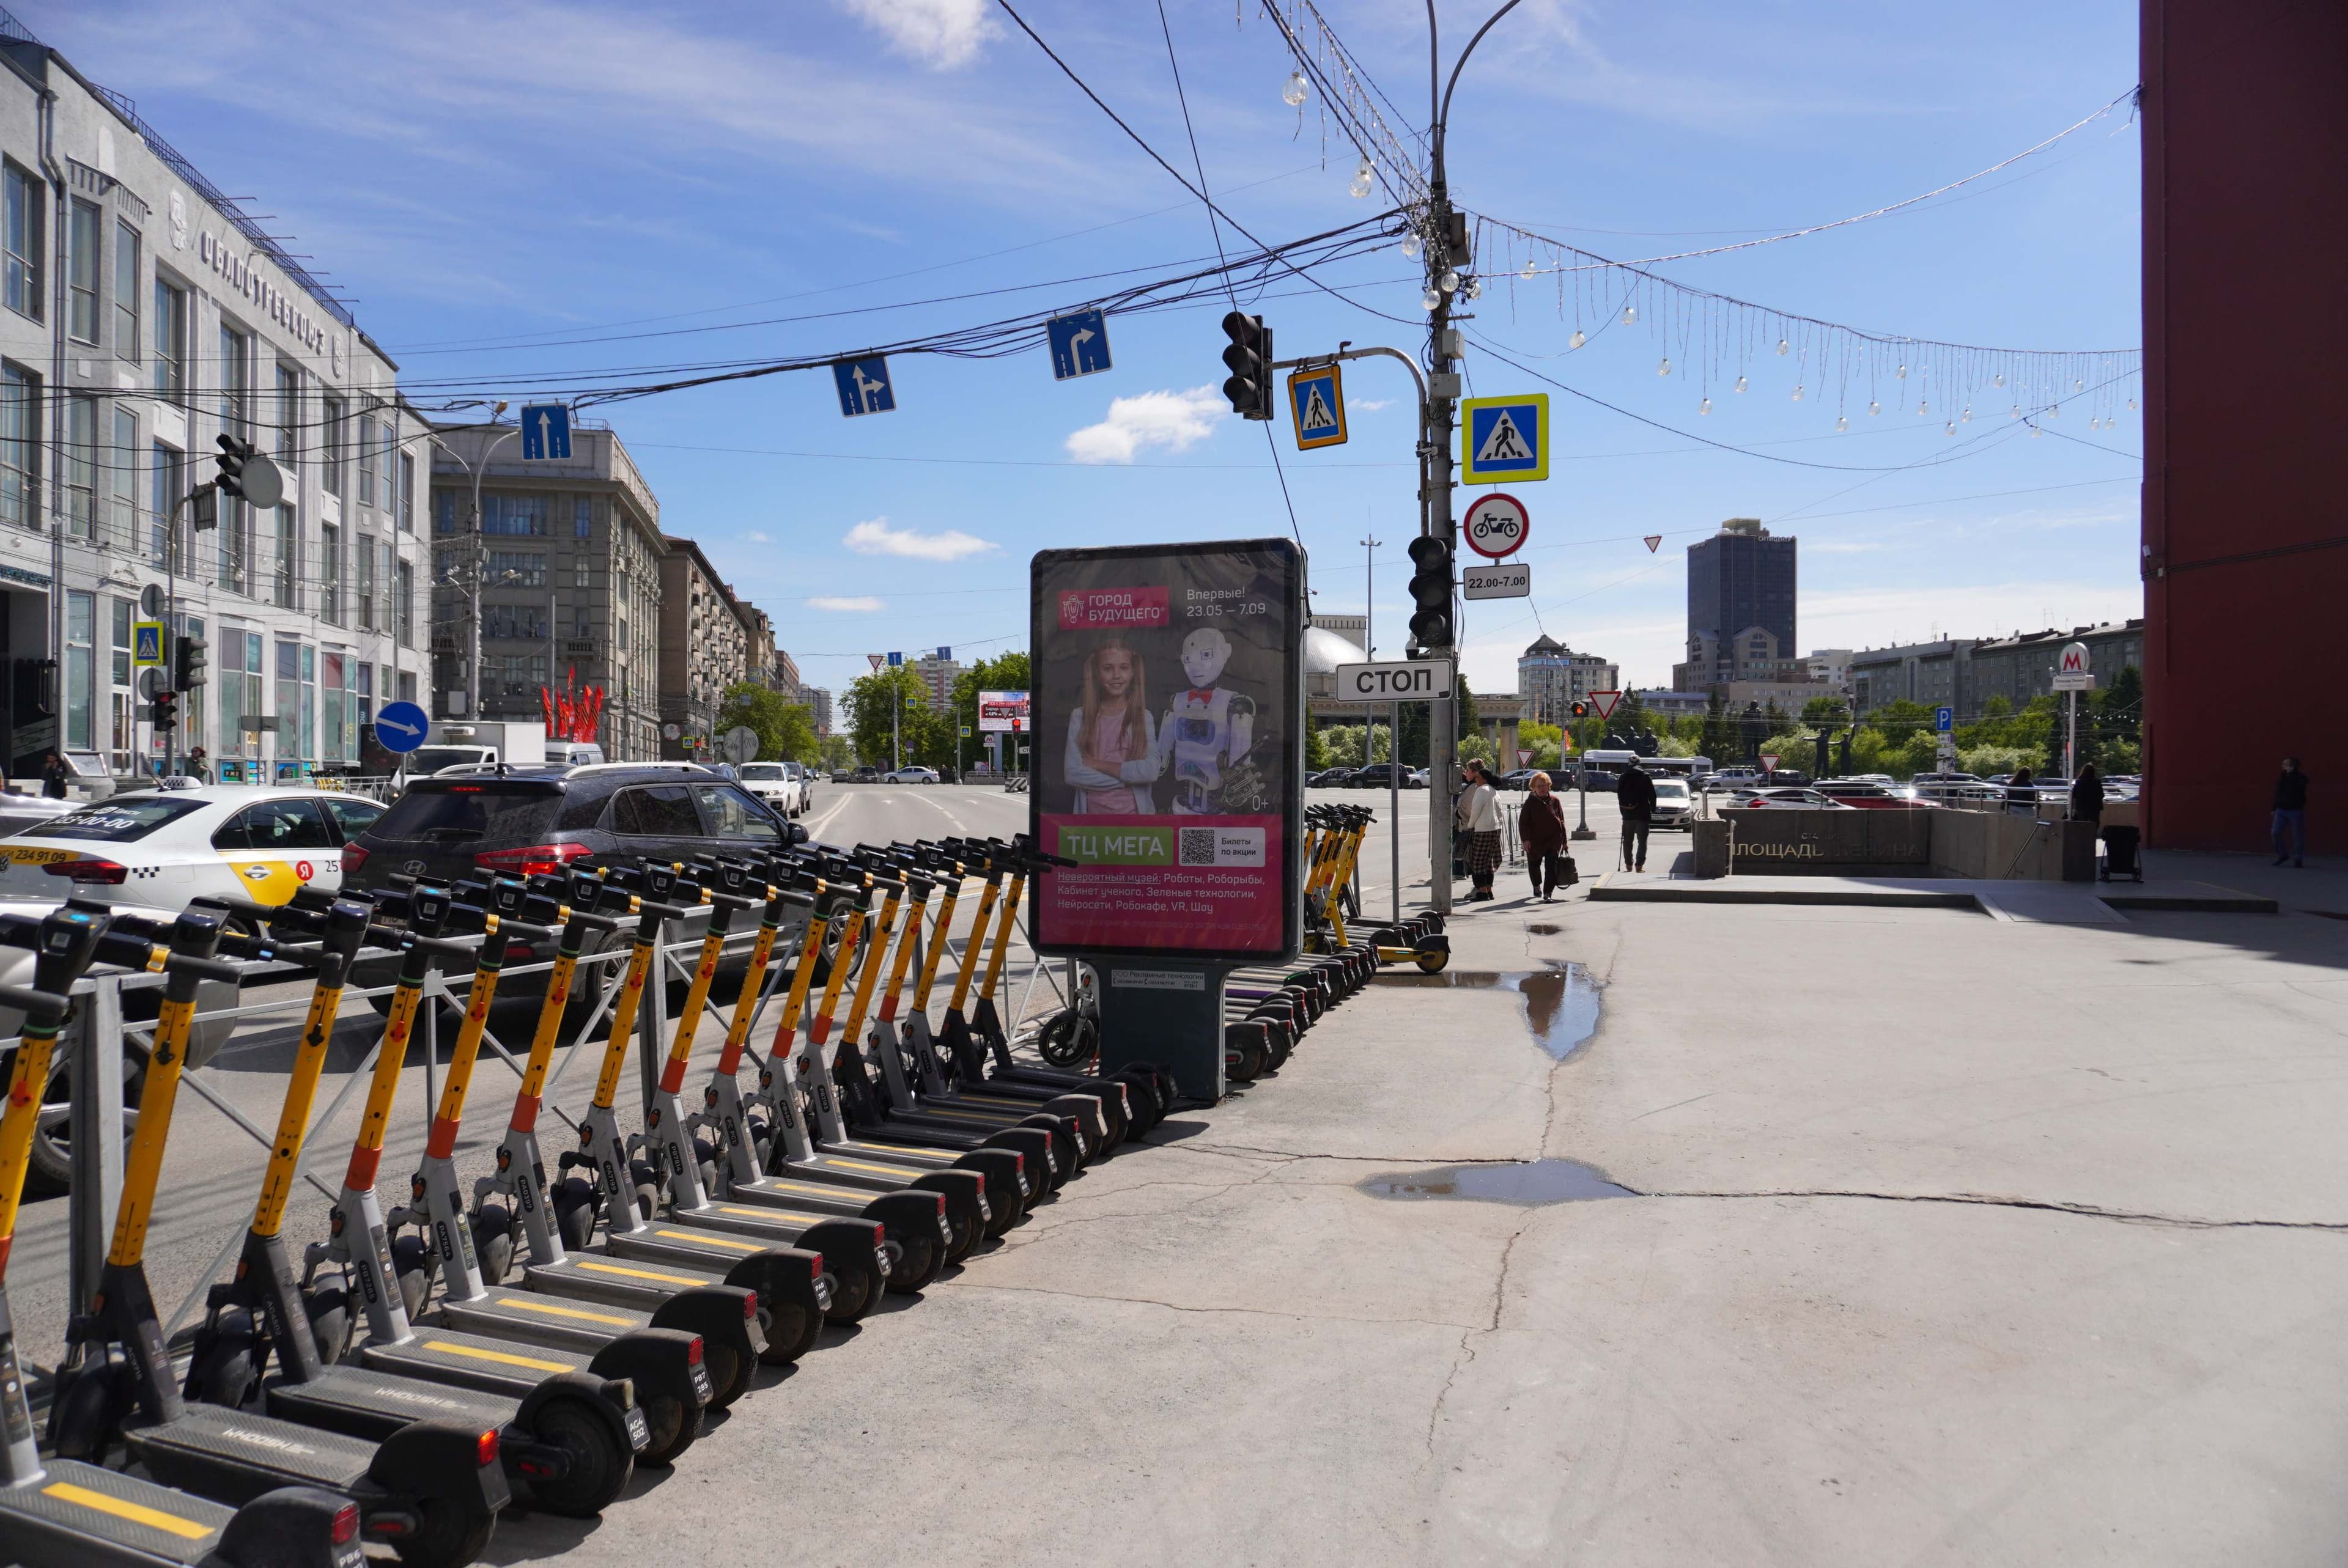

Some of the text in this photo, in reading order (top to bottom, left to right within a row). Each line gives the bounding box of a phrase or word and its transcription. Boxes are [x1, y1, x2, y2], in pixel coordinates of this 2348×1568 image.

[202, 230, 326, 356] ОБЛПОТРЕБСОЮЗ
[1469, 576, 1526, 589] 22.00-7.00
[1089, 594, 1132, 608] ГОРОД
[1187, 587, 1246, 601] Впервые!
[1187, 605, 1222, 617] 23.05
[1239, 603, 1266, 616] 7.09
[1356, 669, 1431, 693] СТОП
[1252, 795, 1269, 811] 0+
[1067, 836, 1164, 858] ТЦ МЕГА
[1232, 848, 1256, 857] акции
[15, 850, 35, 861] 234
[36, 850, 49, 861] 91
[51, 852, 67, 862] 09
[325, 860, 341, 872] 25
[1058, 872, 1265, 886] Невероятный музей: Роботы, Роборыбы,
[1058, 886, 1257, 900] Кабинет ученого, Зеленые технологии,
[1058, 900, 1213, 914] Нейросети, Робокафе, VR, Шоу
[606, 1164, 616, 1191] PA7199
[520, 1179, 533, 1209] PA0397
[438, 1224, 451, 1257] PA7564
[360, 1264, 374, 1300] PB7285
[818, 1290, 827, 1300] 397
[694, 1371, 706, 1385] PB7
[697, 1382, 709, 1394] 285
[630, 1417, 643, 1433] AG4
[632, 1427, 646, 1441] 502
